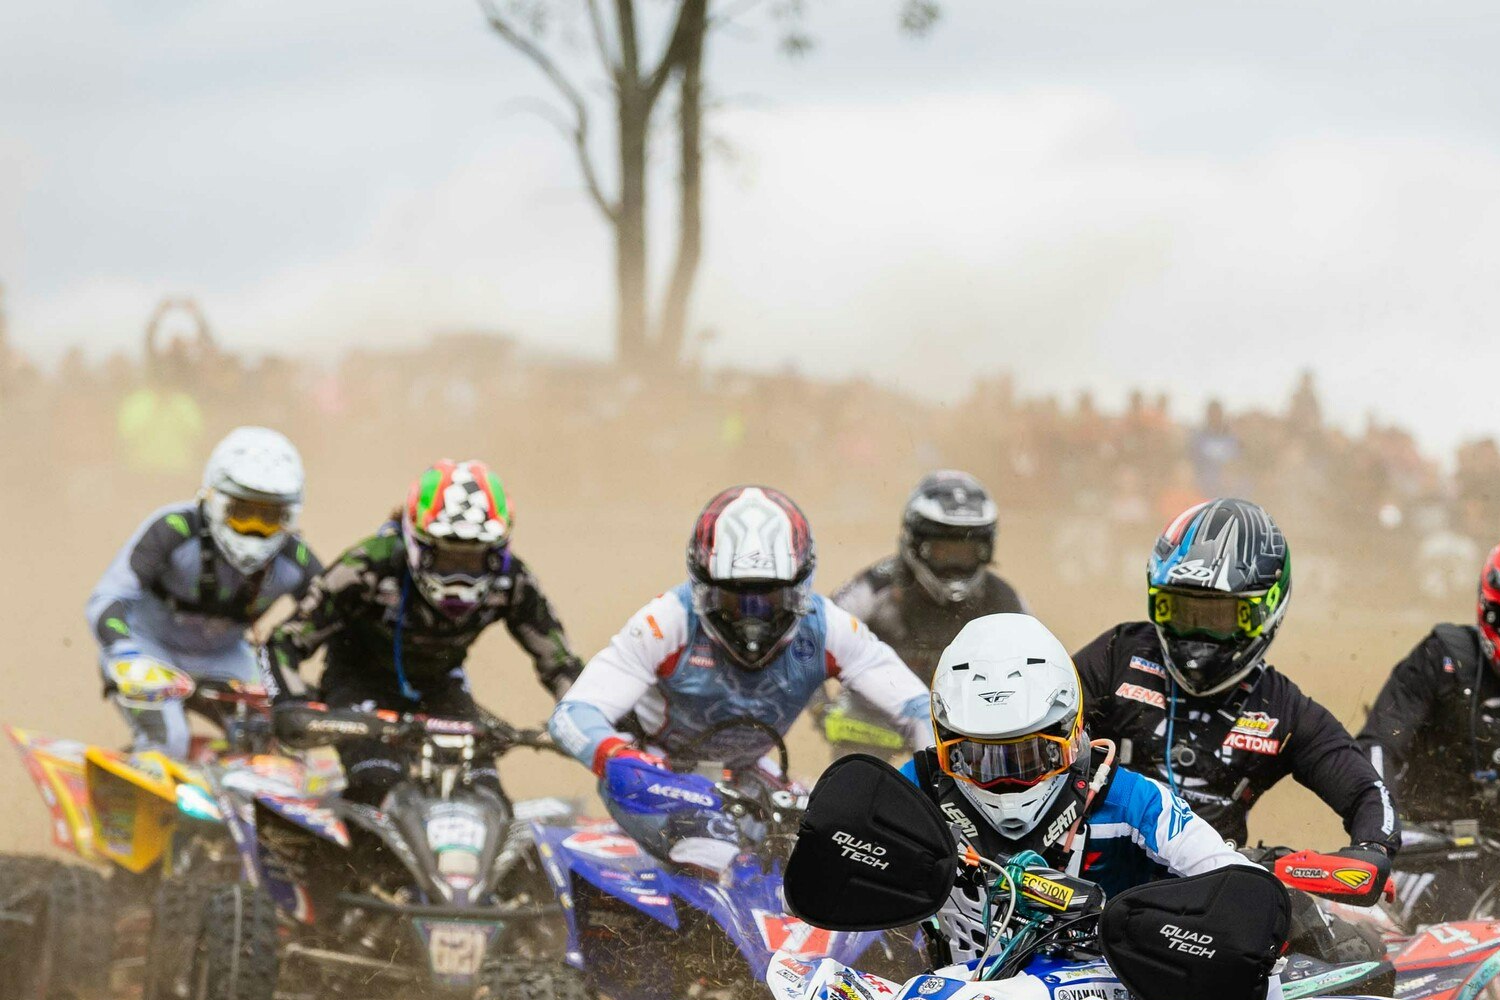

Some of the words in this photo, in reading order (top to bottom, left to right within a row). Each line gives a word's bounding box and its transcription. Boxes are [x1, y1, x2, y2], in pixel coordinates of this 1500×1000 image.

[1042, 800, 1078, 847] LEATT
[831, 830, 887, 857] QUAD
[840, 844, 890, 871] TECH
[1019, 872, 1071, 901] ECISION
[1160, 923, 1214, 944] QUAD
[1167, 937, 1217, 959] TECH
